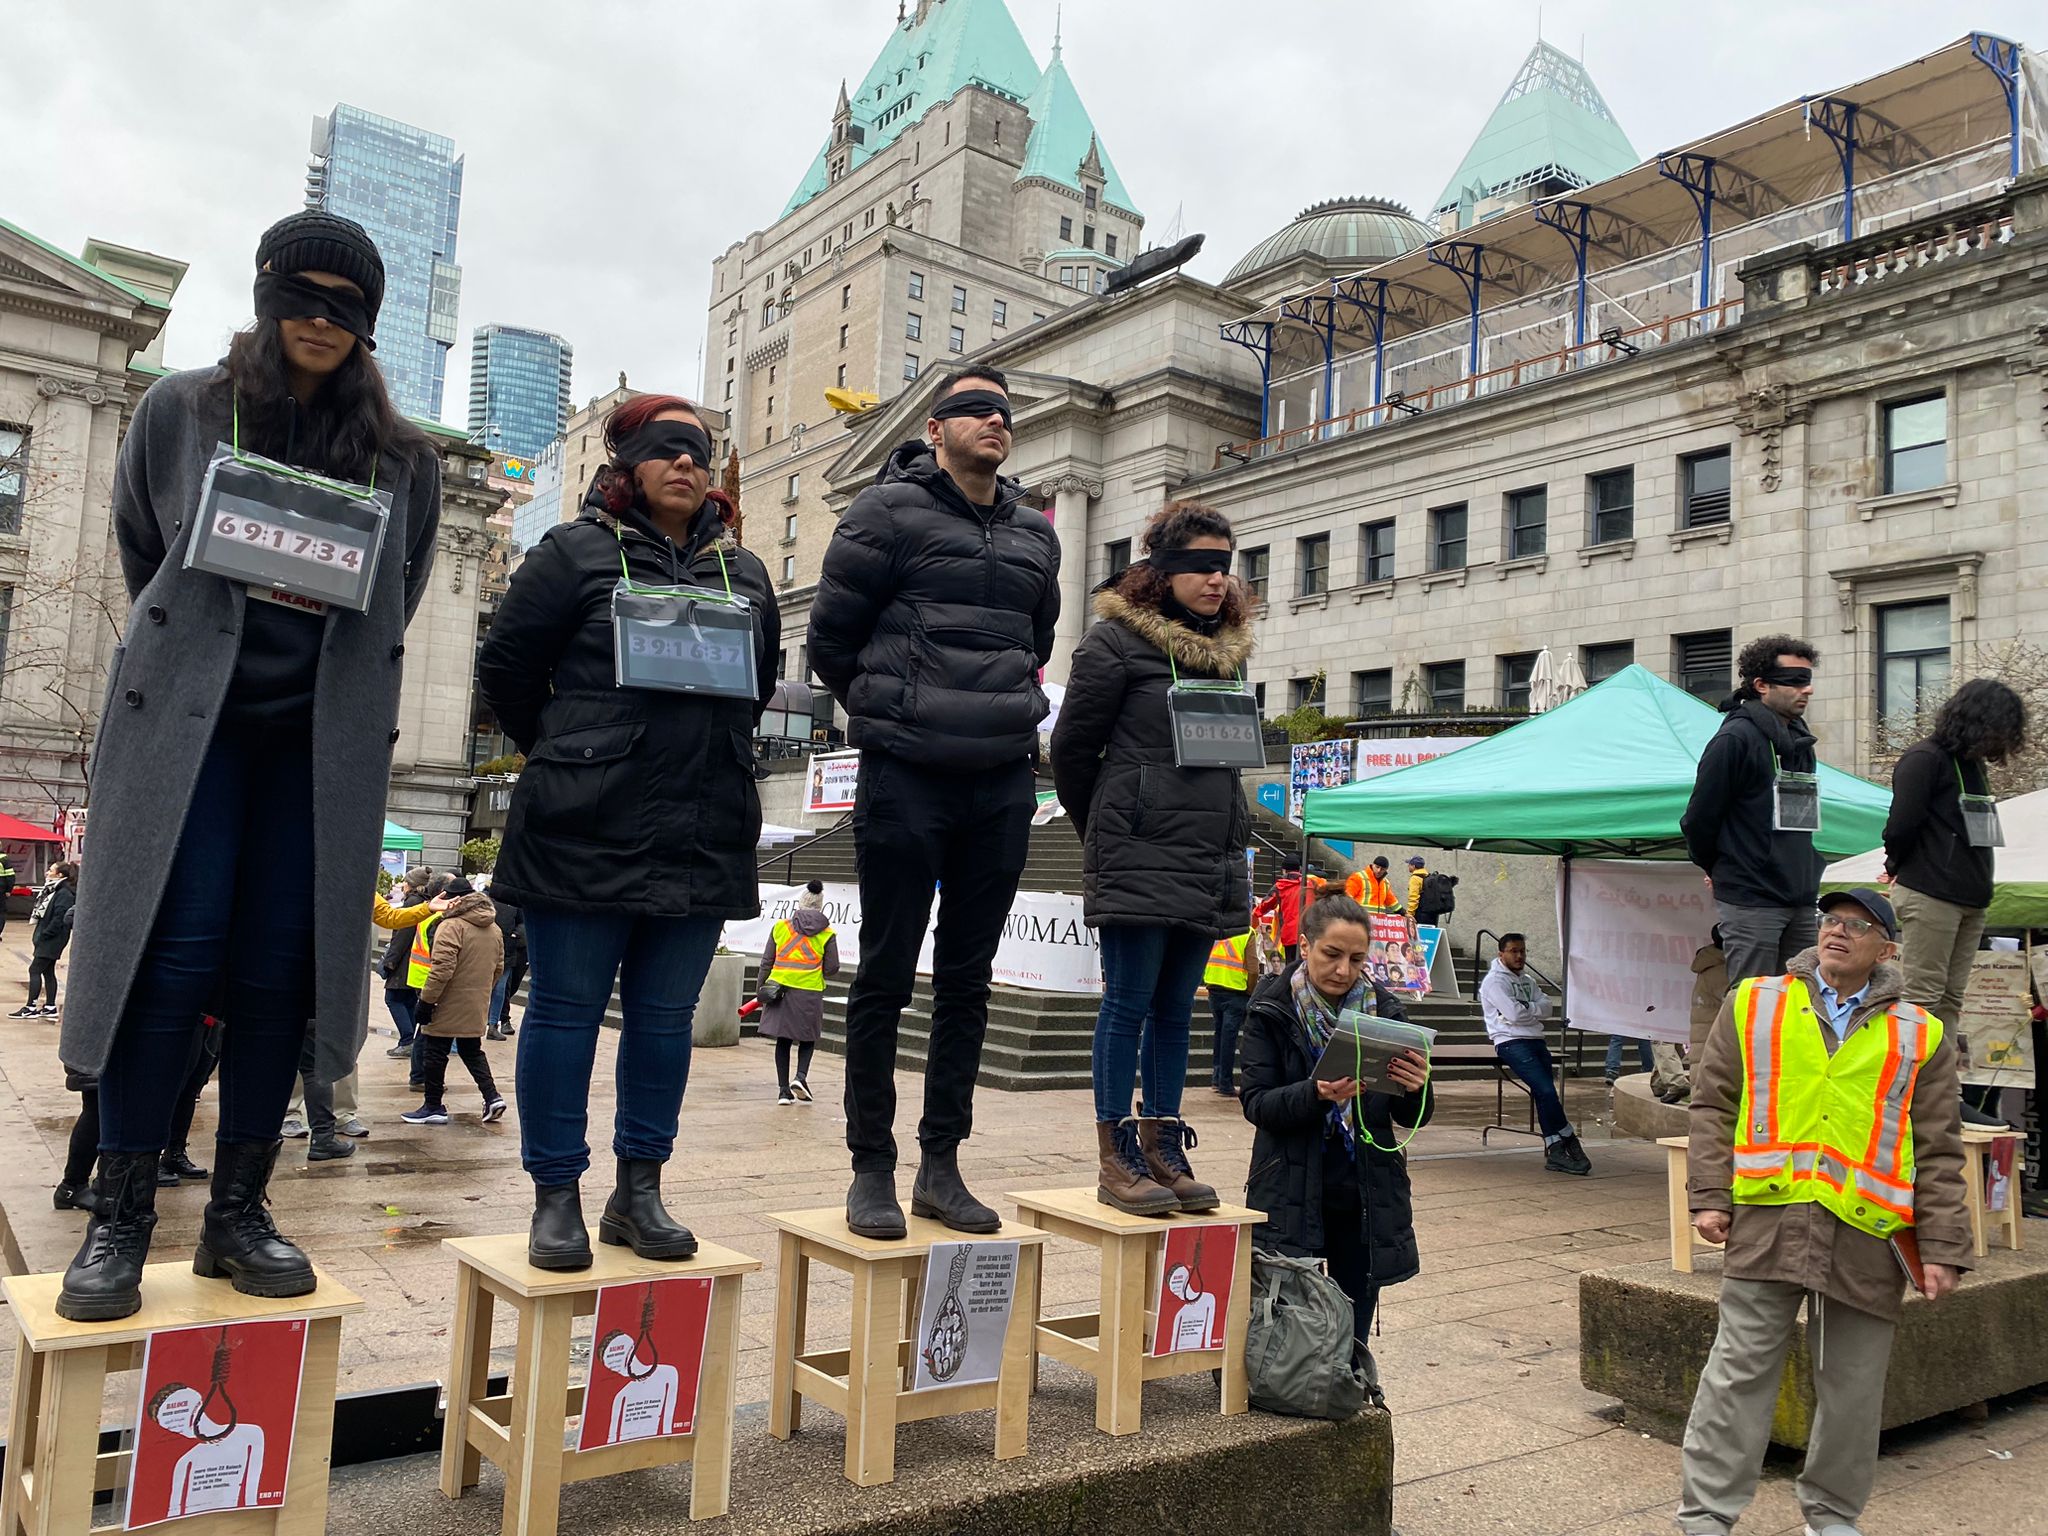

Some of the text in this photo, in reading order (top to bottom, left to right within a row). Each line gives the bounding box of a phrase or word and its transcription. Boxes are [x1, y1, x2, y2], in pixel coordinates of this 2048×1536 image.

[217, 516, 358, 569] 69:17:34
[632, 636, 740, 663] 39:16:37
[1366, 754, 1392, 767] FREE
[1395, 753, 1414, 767] ALL
[1388, 929, 1404, 939] Iran
